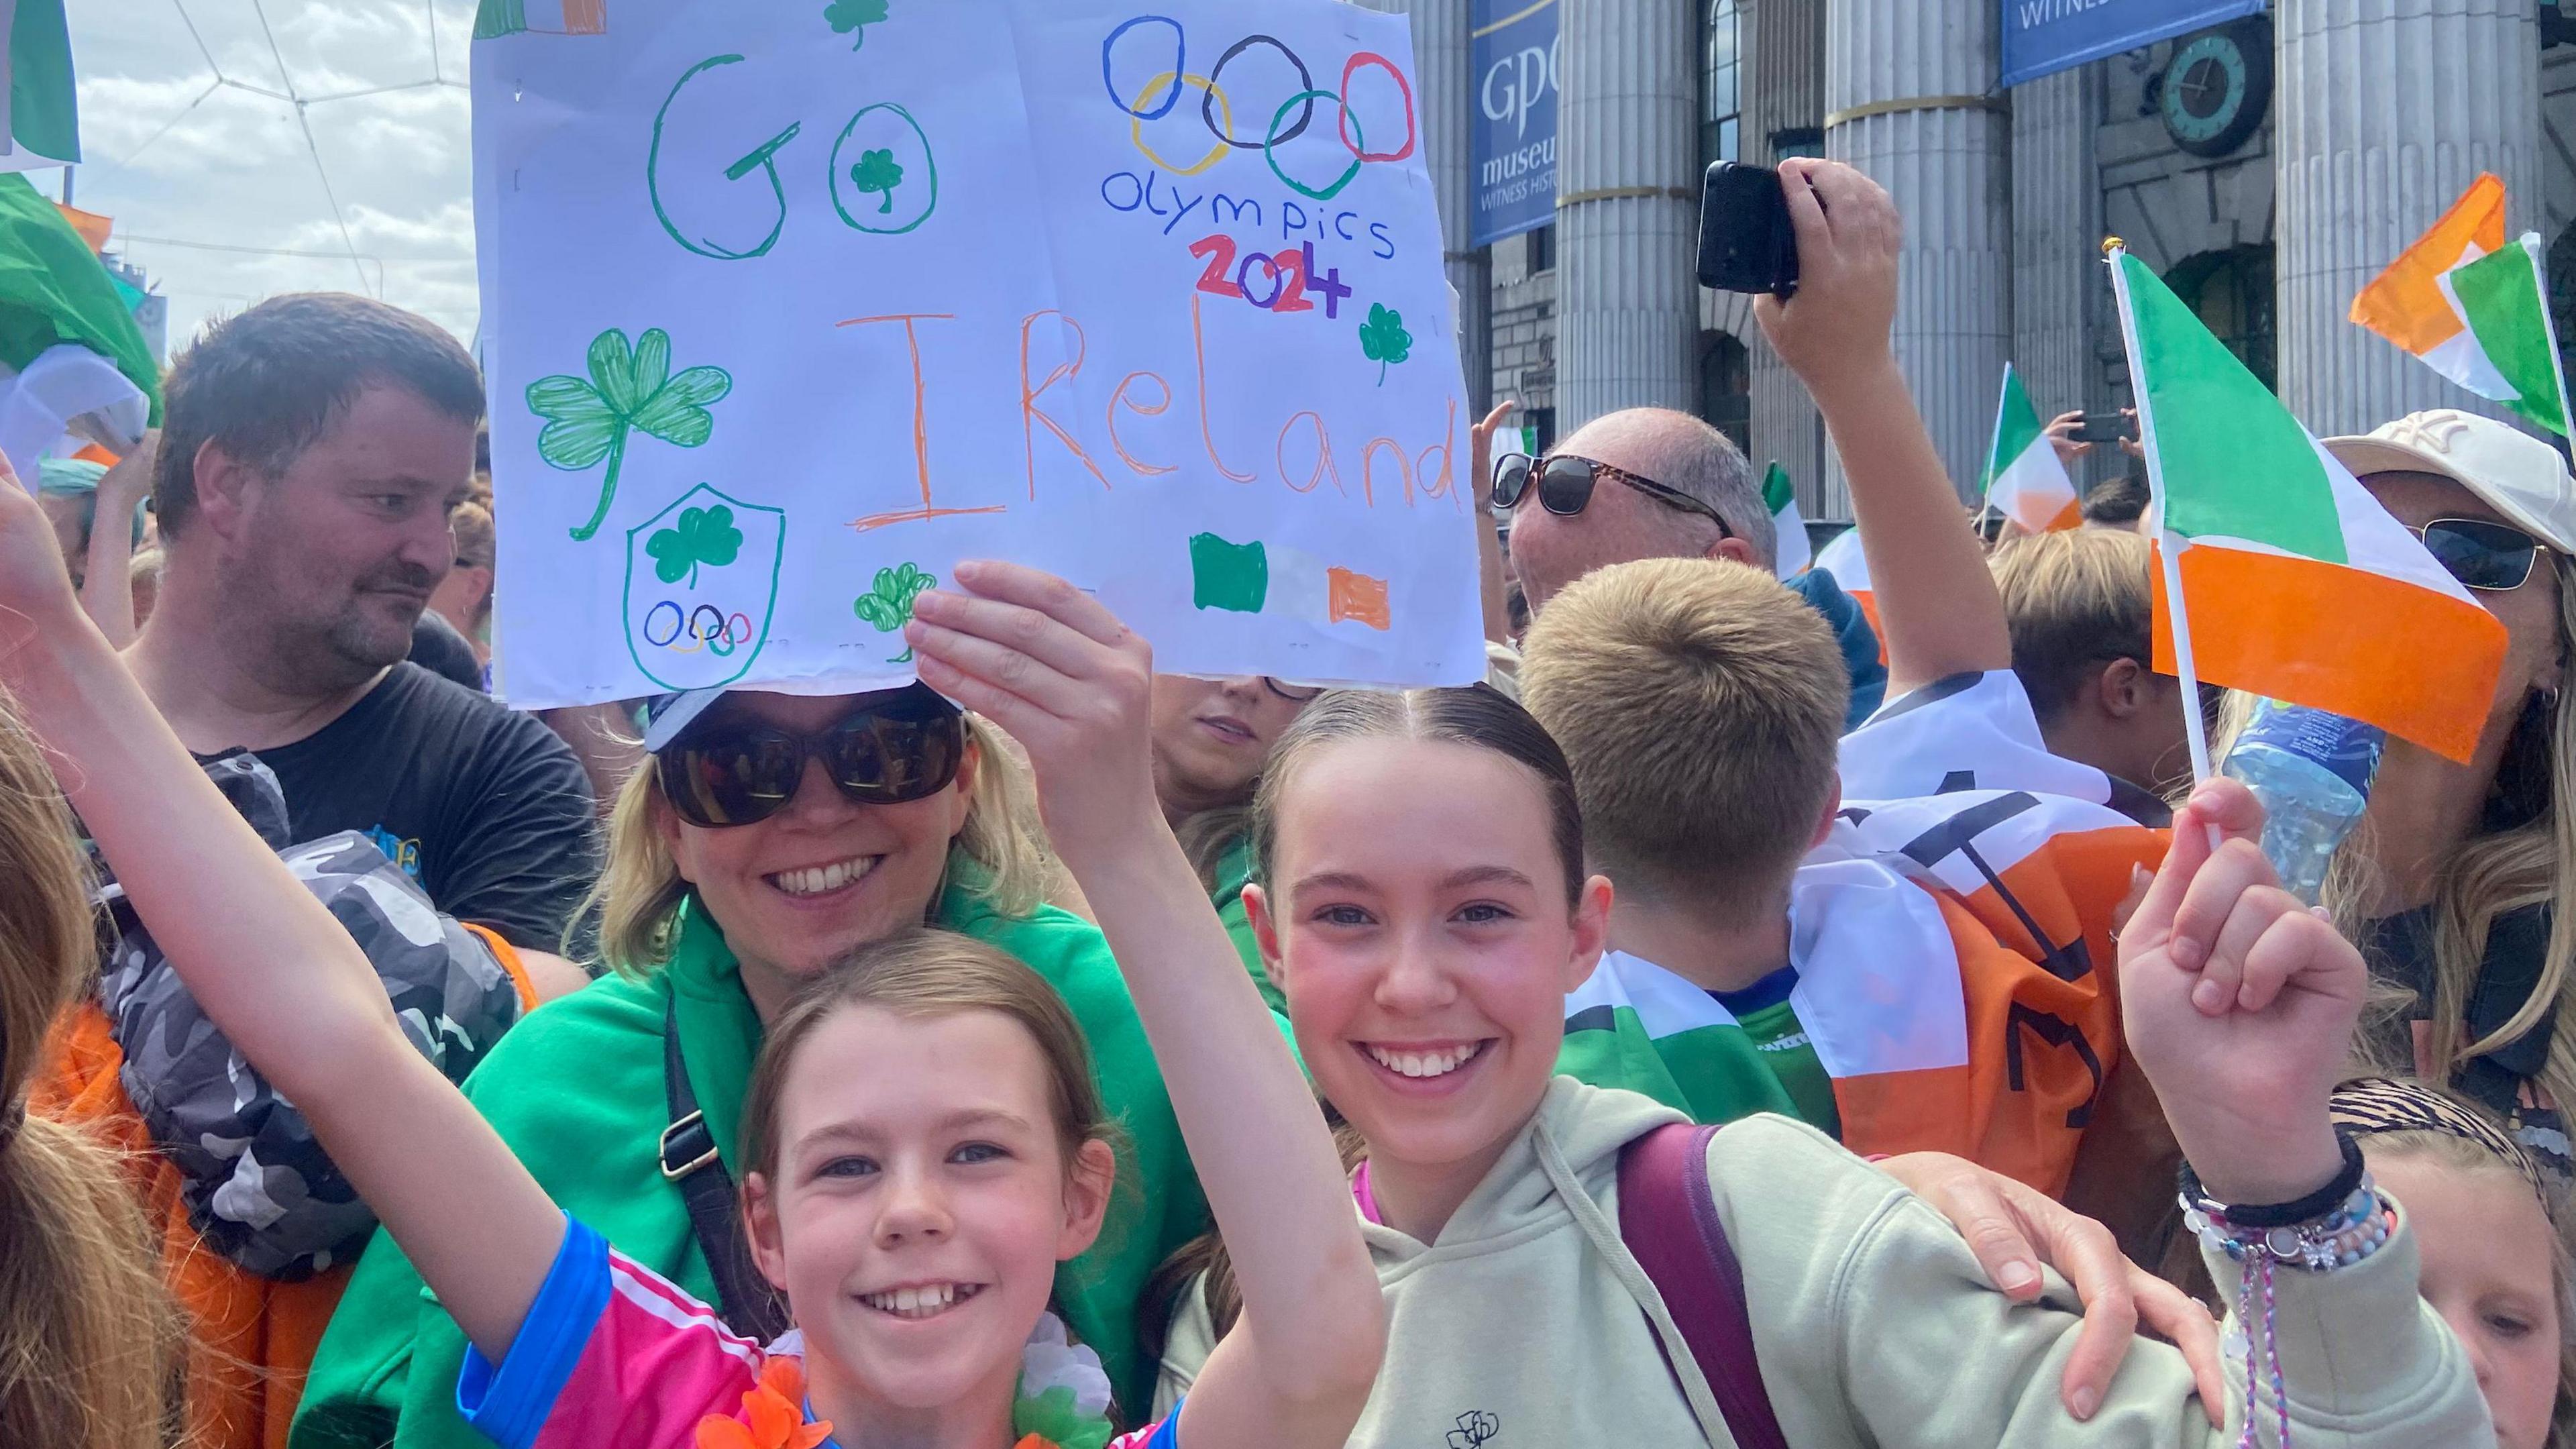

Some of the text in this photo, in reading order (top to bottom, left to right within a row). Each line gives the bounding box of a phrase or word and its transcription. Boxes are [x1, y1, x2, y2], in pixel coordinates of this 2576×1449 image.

[1483, 134, 1556, 186] museu
[1481, 178, 1527, 212] WITNESS
[1188, 233, 1352, 319] 2024
